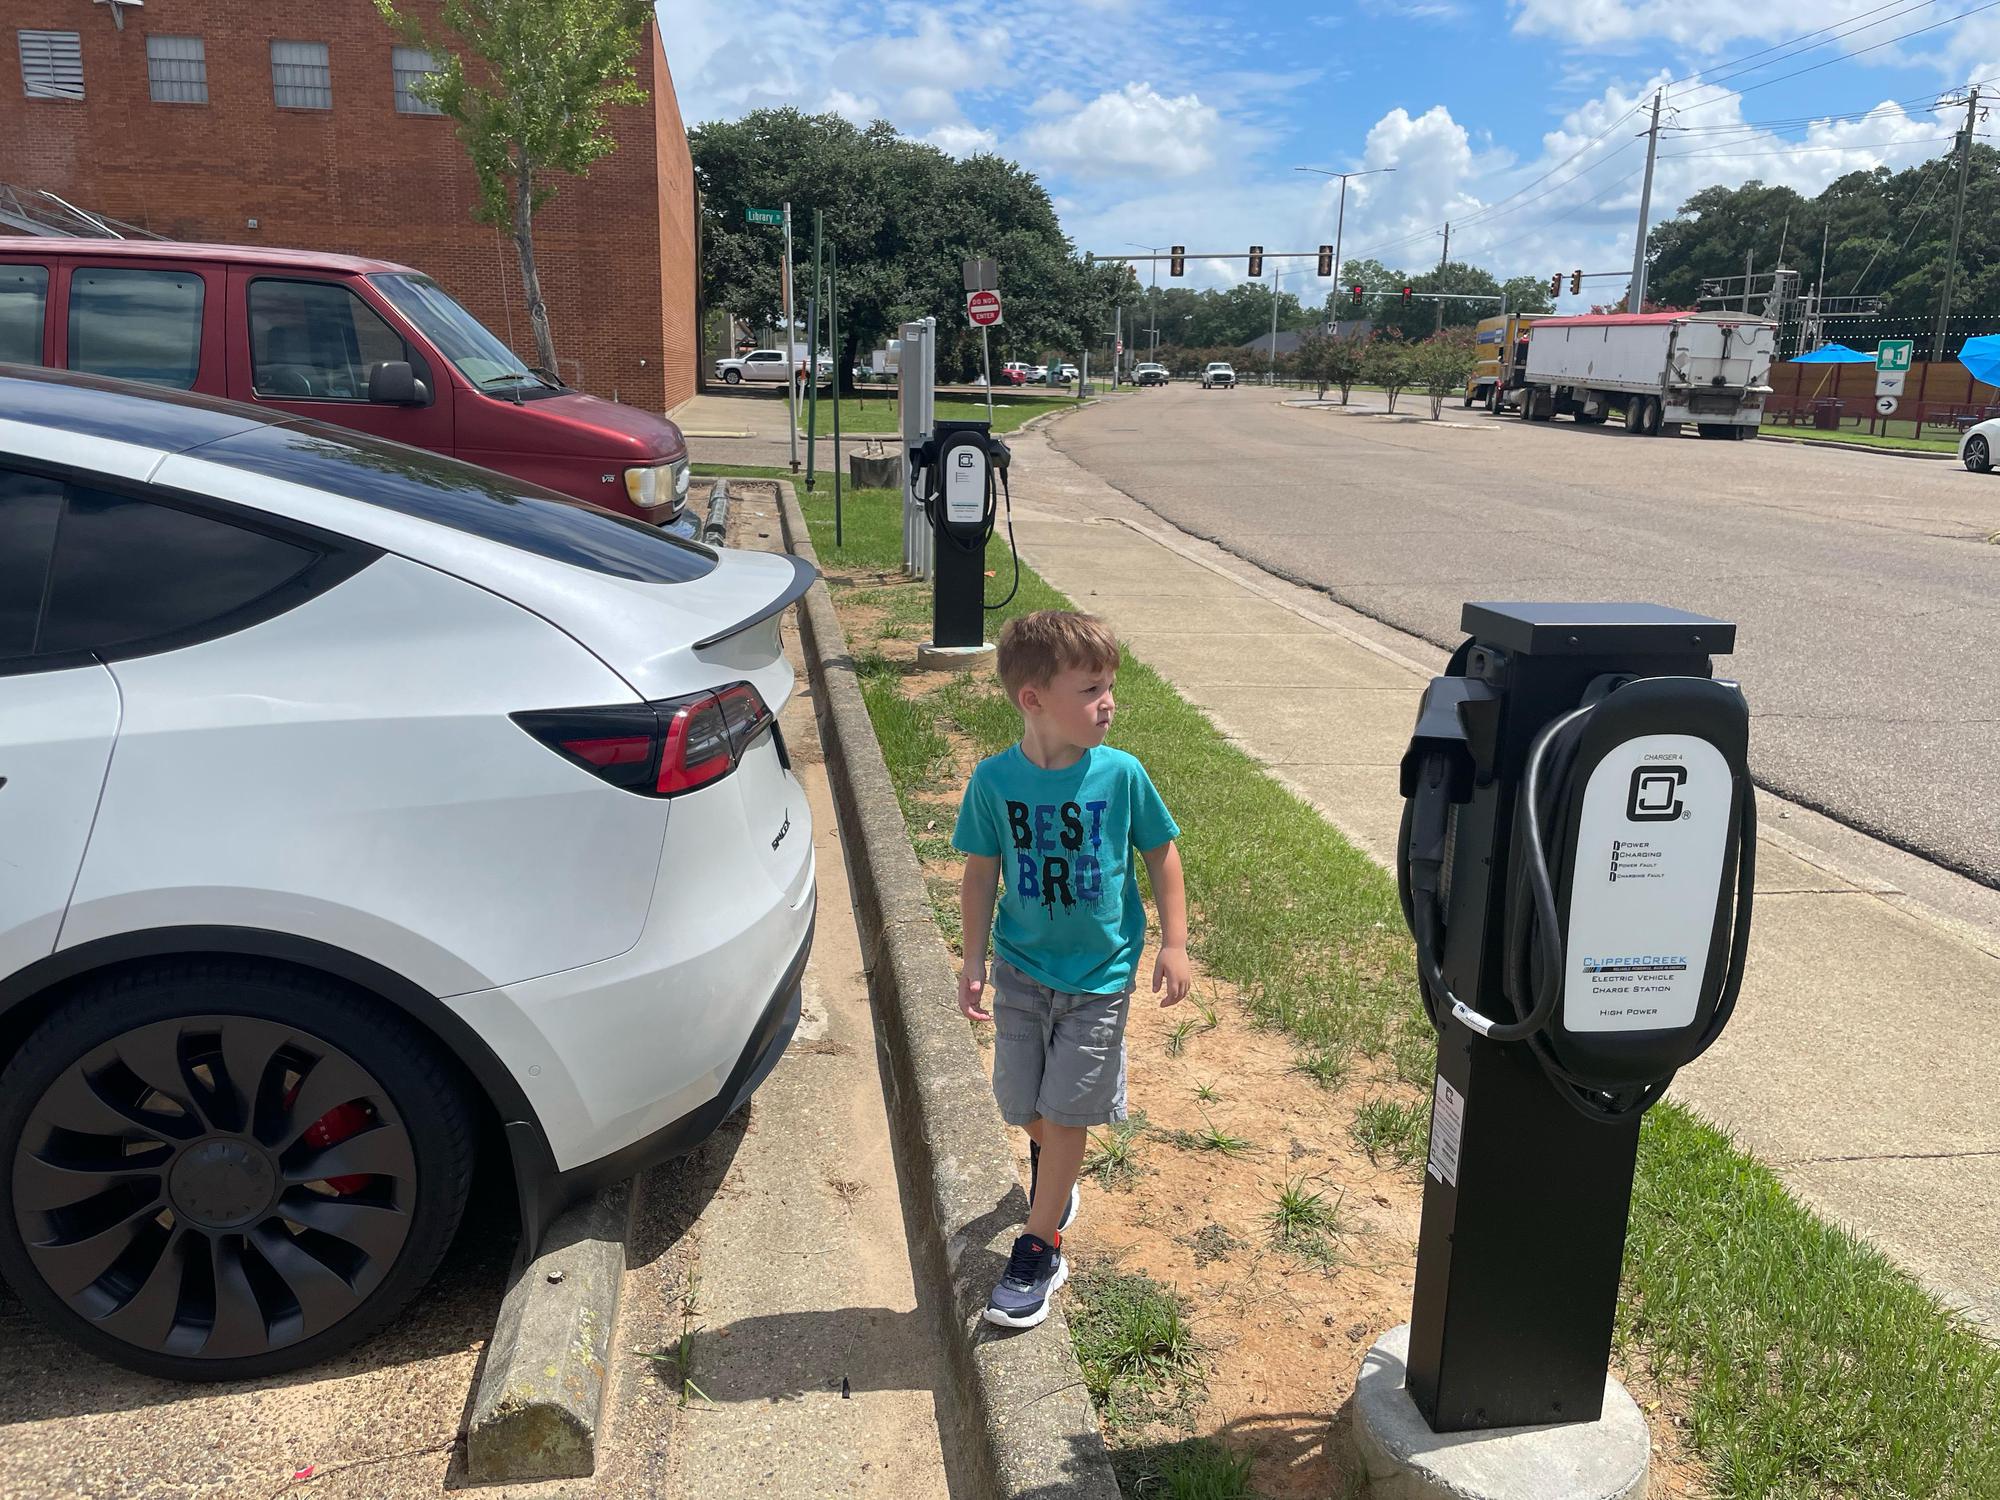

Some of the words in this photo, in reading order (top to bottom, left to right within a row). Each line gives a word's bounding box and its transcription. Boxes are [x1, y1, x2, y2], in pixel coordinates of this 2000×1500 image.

[748, 211, 773, 224] Library
[1643, 753, 1678, 761] CHARGER
[1005, 799, 1107, 854] BEST
[1017, 852, 1104, 908] BRO
[1583, 955, 1688, 967] CLIPPERCREEK
[1591, 975, 1634, 983] ELECTRIC
[1632, 985, 1671, 993] STATION
[1599, 1009, 1623, 1017] HIGH
[1626, 1008, 1658, 1016] POWER
